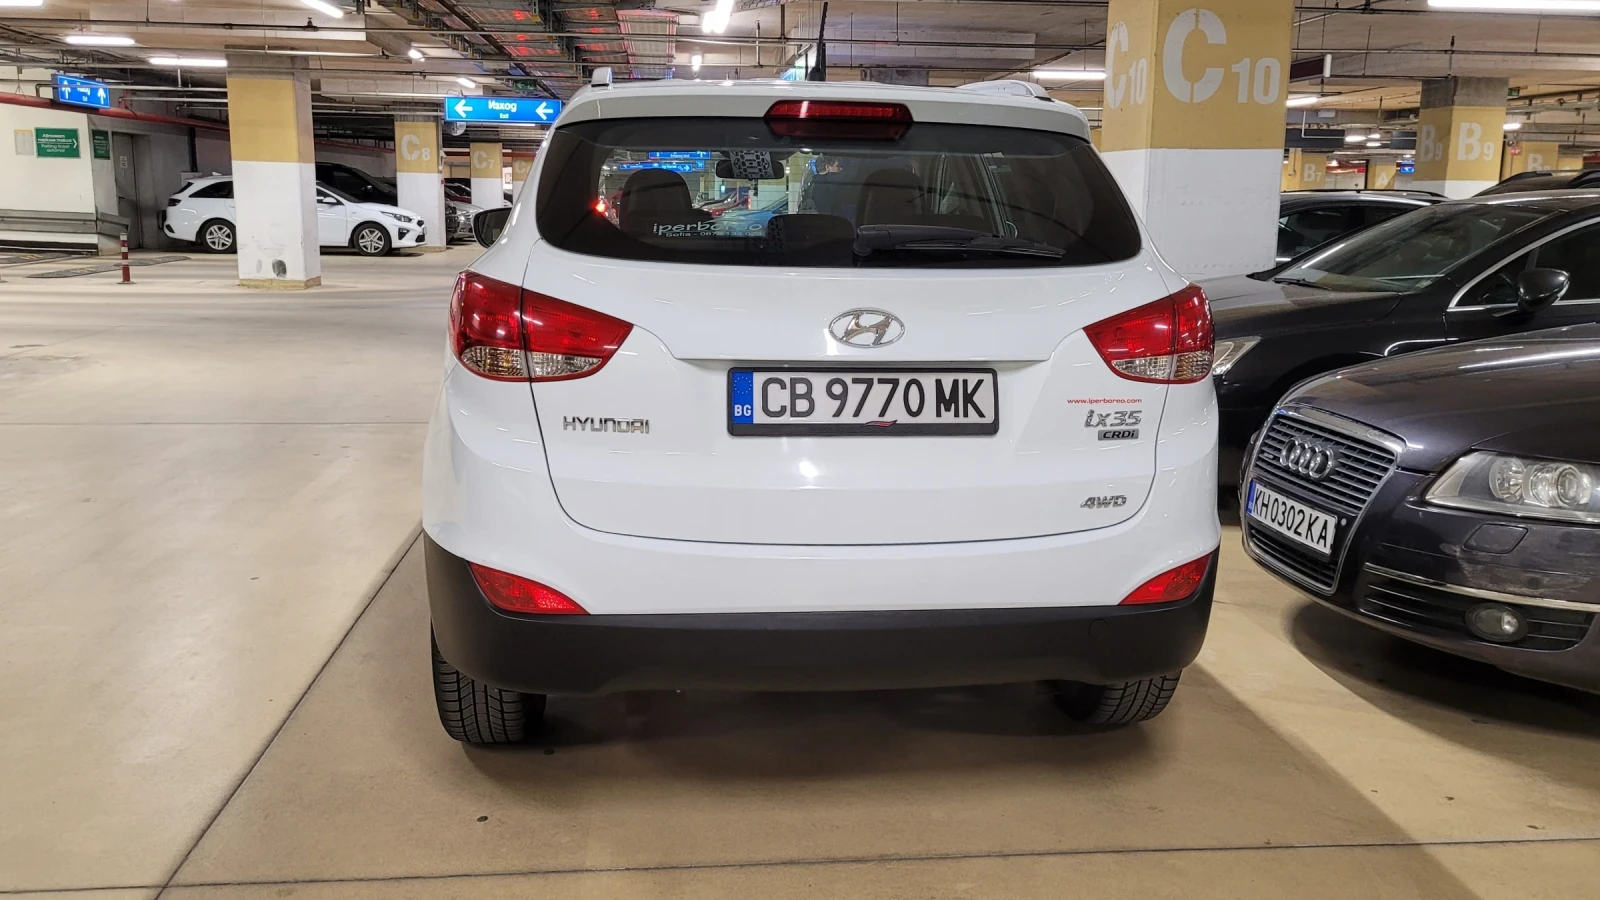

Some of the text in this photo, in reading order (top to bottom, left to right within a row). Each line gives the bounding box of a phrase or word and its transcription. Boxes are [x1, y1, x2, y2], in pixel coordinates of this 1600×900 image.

[1105, 21, 1147, 110] C10
[1163, 8, 1281, 105] C10
[401, 134, 430, 161] C8
[1420, 124, 1443, 161] B9
[1457, 122, 1495, 161] B9
[473, 150, 494, 169] C7
[1303, 163, 1321, 182] B7
[734, 377, 986, 418] BG CB 9770 MK
[563, 416, 650, 434] HYUNDAI
[1084, 409, 1143, 428] ix35
[1102, 430, 1136, 439] CRDi
[1080, 495, 1127, 509] 4WD
